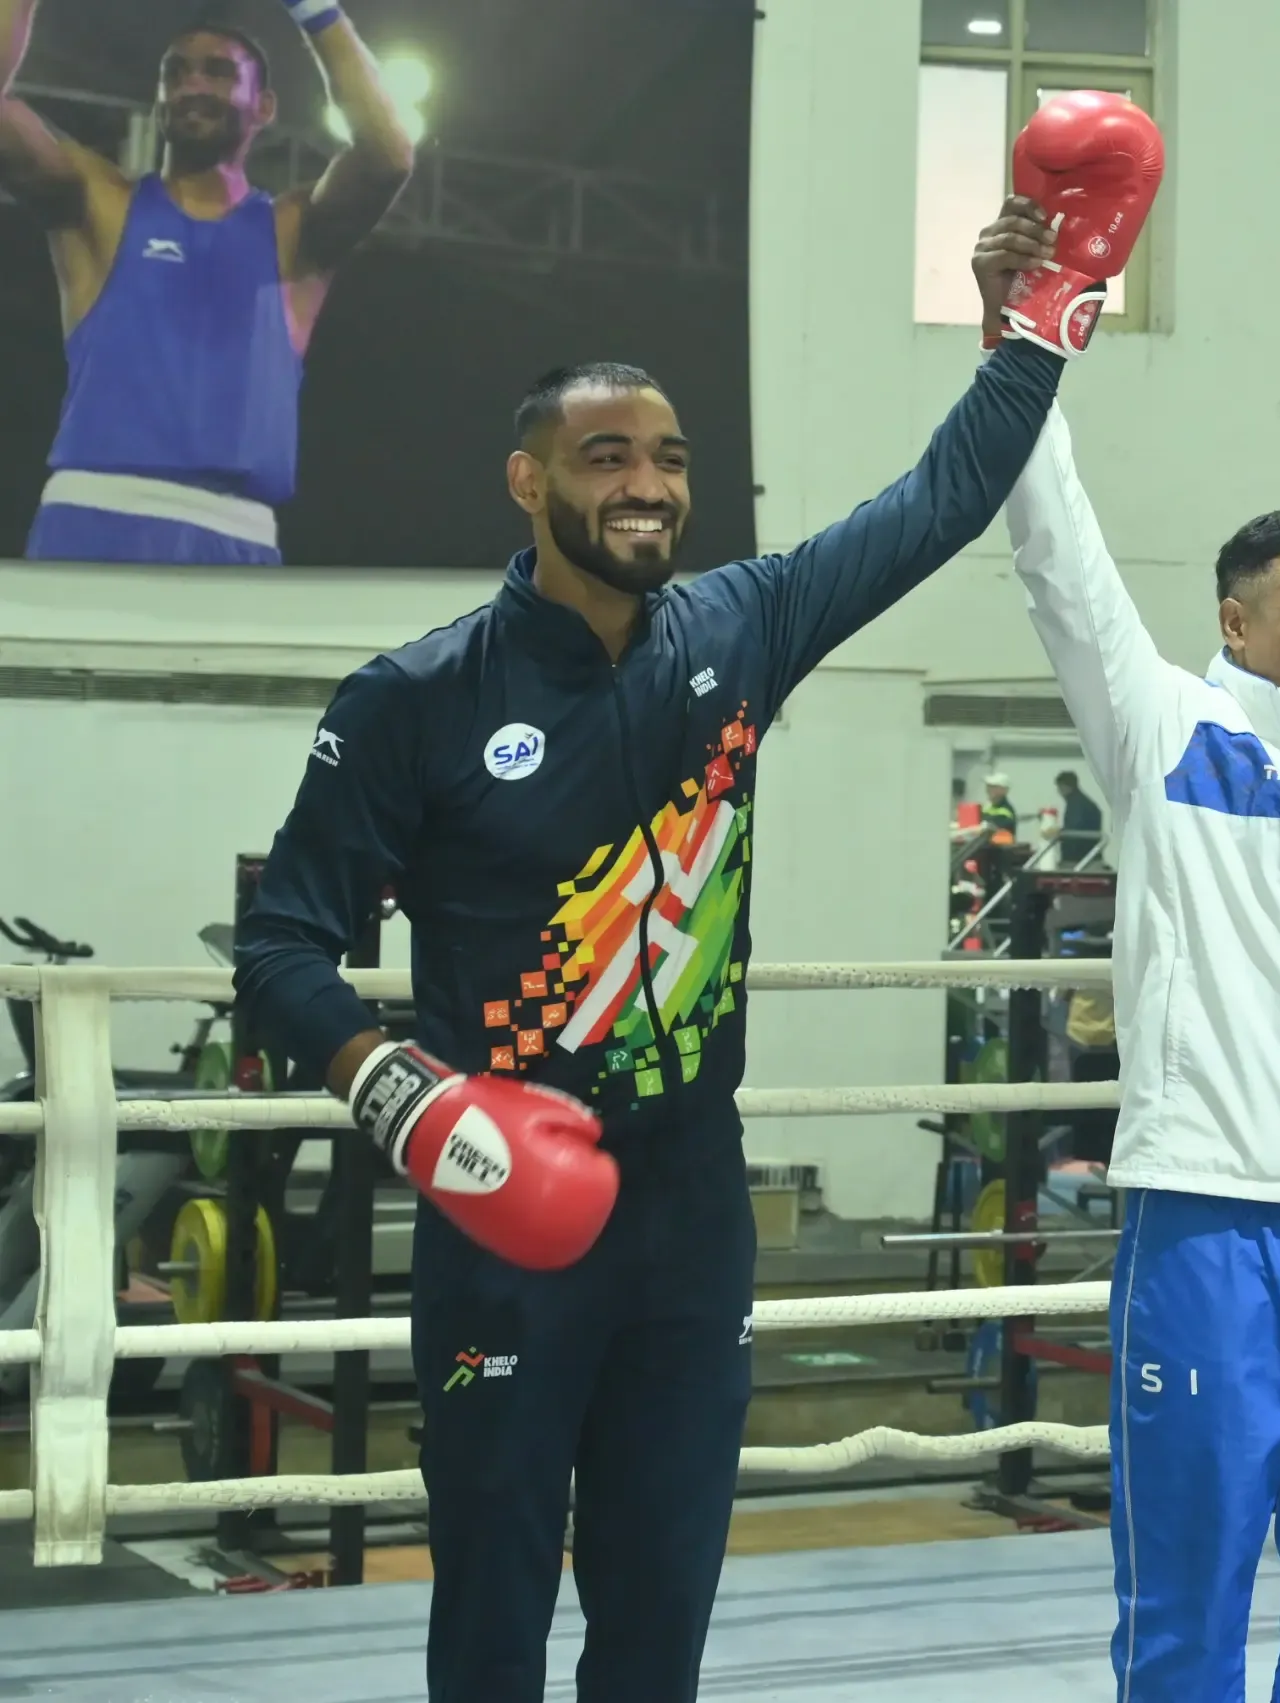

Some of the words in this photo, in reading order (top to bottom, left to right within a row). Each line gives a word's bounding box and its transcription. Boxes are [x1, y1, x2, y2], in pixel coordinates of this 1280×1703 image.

[689, 666, 715, 688] KHELO
[694, 678, 718, 697] INDIA
[493, 736, 539, 765] SAI
[484, 1355, 518, 1368] KHELO
[483, 1366, 513, 1378] INDIA
